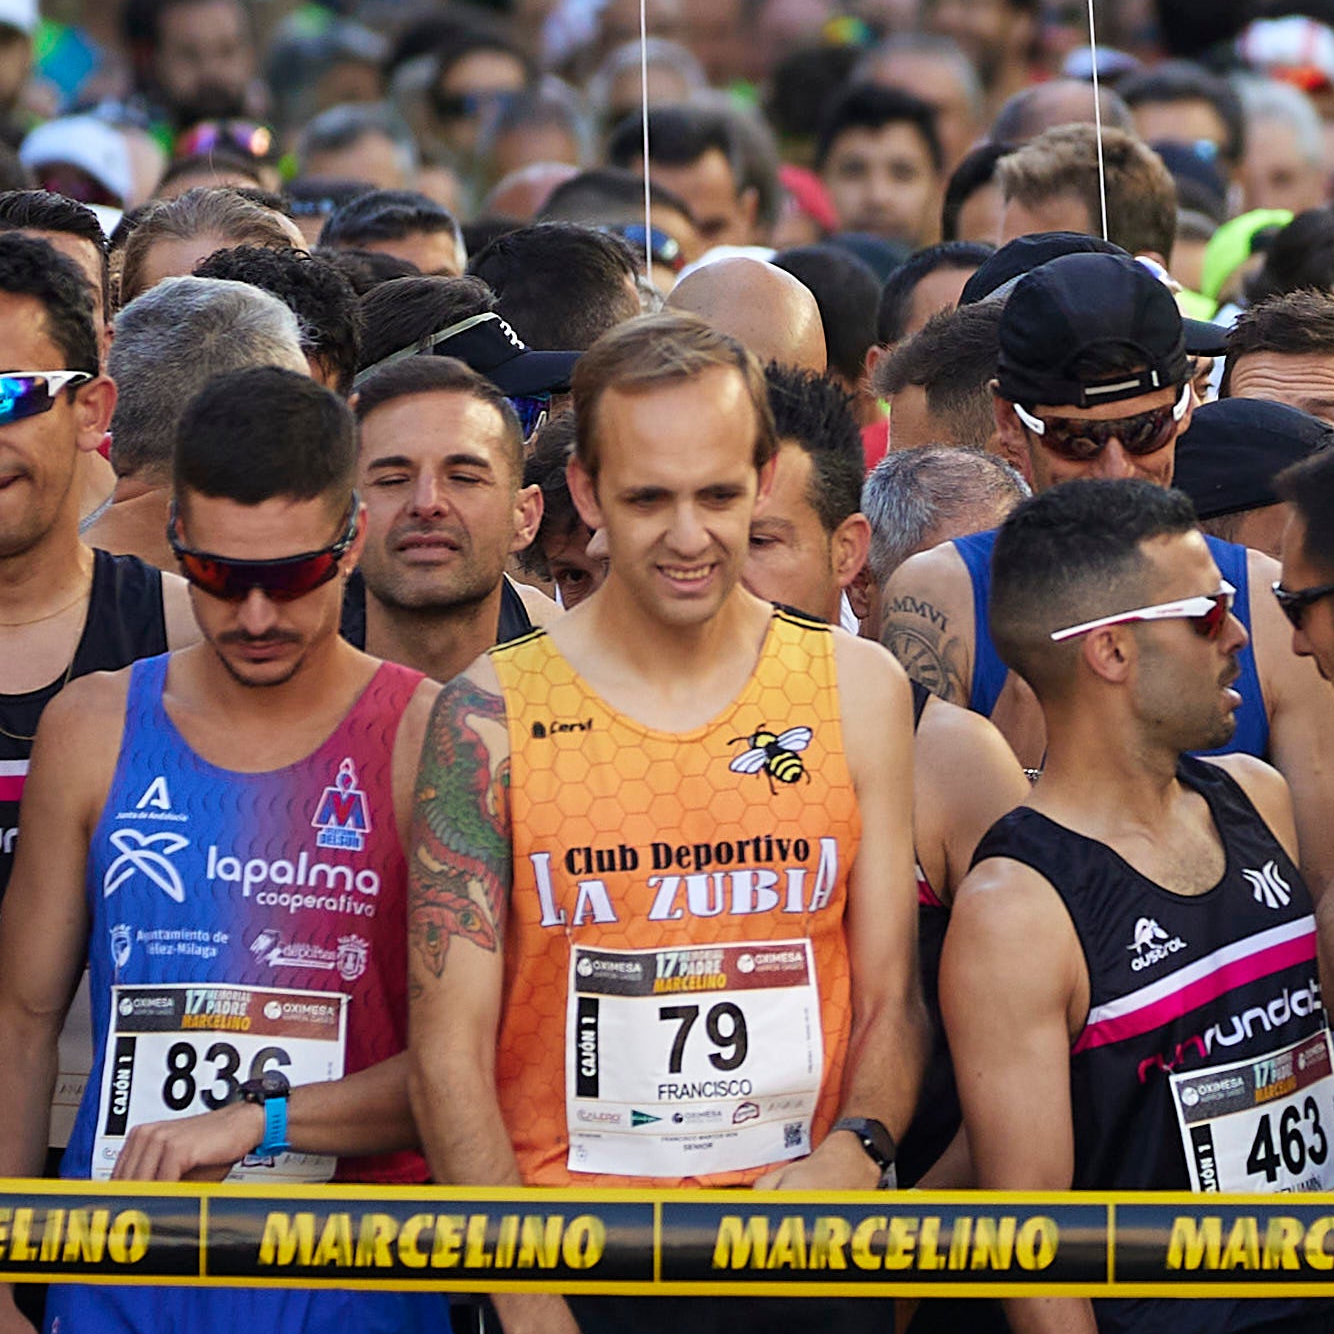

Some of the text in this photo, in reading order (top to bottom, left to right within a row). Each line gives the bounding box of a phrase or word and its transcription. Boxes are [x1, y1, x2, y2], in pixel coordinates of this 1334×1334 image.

[206, 845, 382, 898] lapalma
[564, 835, 811, 876] Club Deportivo
[255, 890, 377, 917] cooperativa
[529, 836, 838, 928] LA ZUBIA
[653, 973, 728, 993] MARCELINO
[679, 960, 722, 977] PADRE
[181, 1013, 251, 1031] MARCELINO
[205, 1000, 248, 1017] PADRE
[282, 1002, 335, 1017] OXIMESA
[578, 1030, 598, 1077] CAJÓN
[659, 1001, 749, 1075] 79
[112, 1067, 130, 1116] CAJÓN
[658, 1079, 753, 1100] FRANCISCO
[1246, 1095, 1329, 1184] 463
[259, 1212, 607, 1268] MARCELINO
[713, 1216, 1060, 1270] MARCELINO
